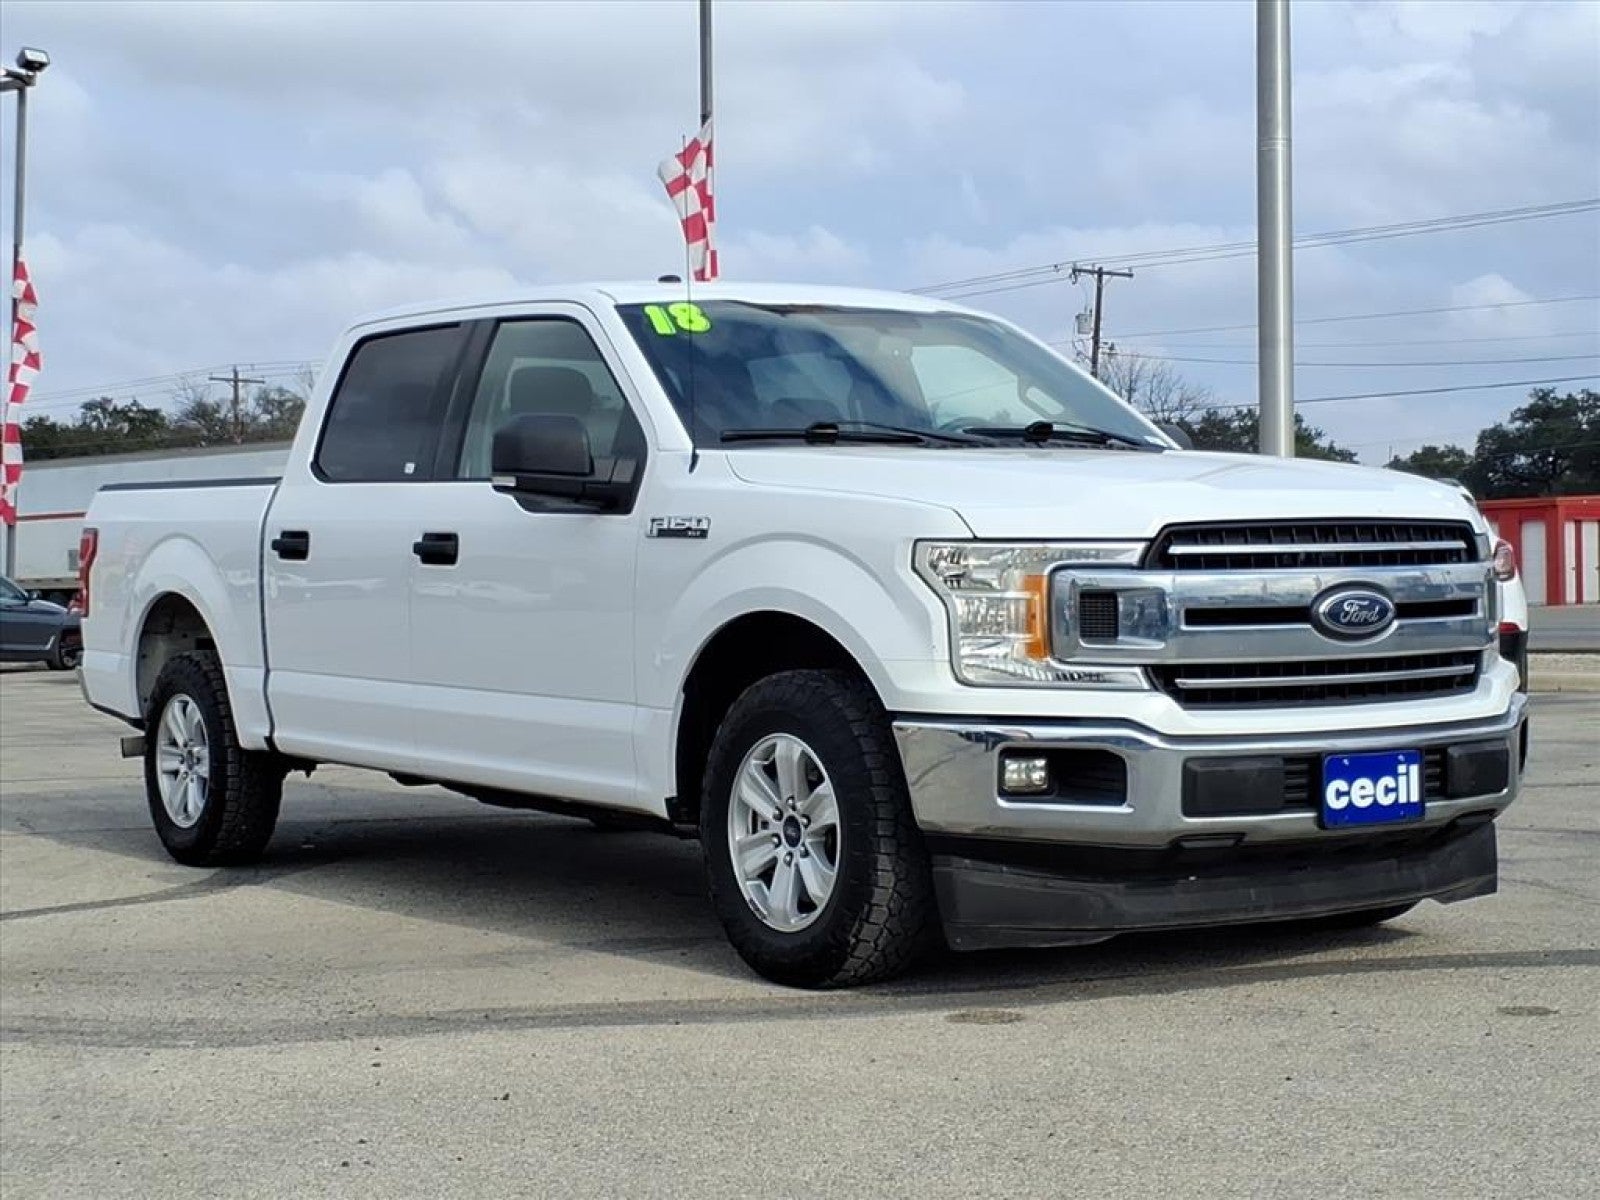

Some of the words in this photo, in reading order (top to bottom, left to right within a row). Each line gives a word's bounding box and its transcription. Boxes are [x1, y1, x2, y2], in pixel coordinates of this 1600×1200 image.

[643, 302, 712, 335] 18
[1340, 599, 1379, 623] Ford
[1325, 763, 1420, 810] cecil
